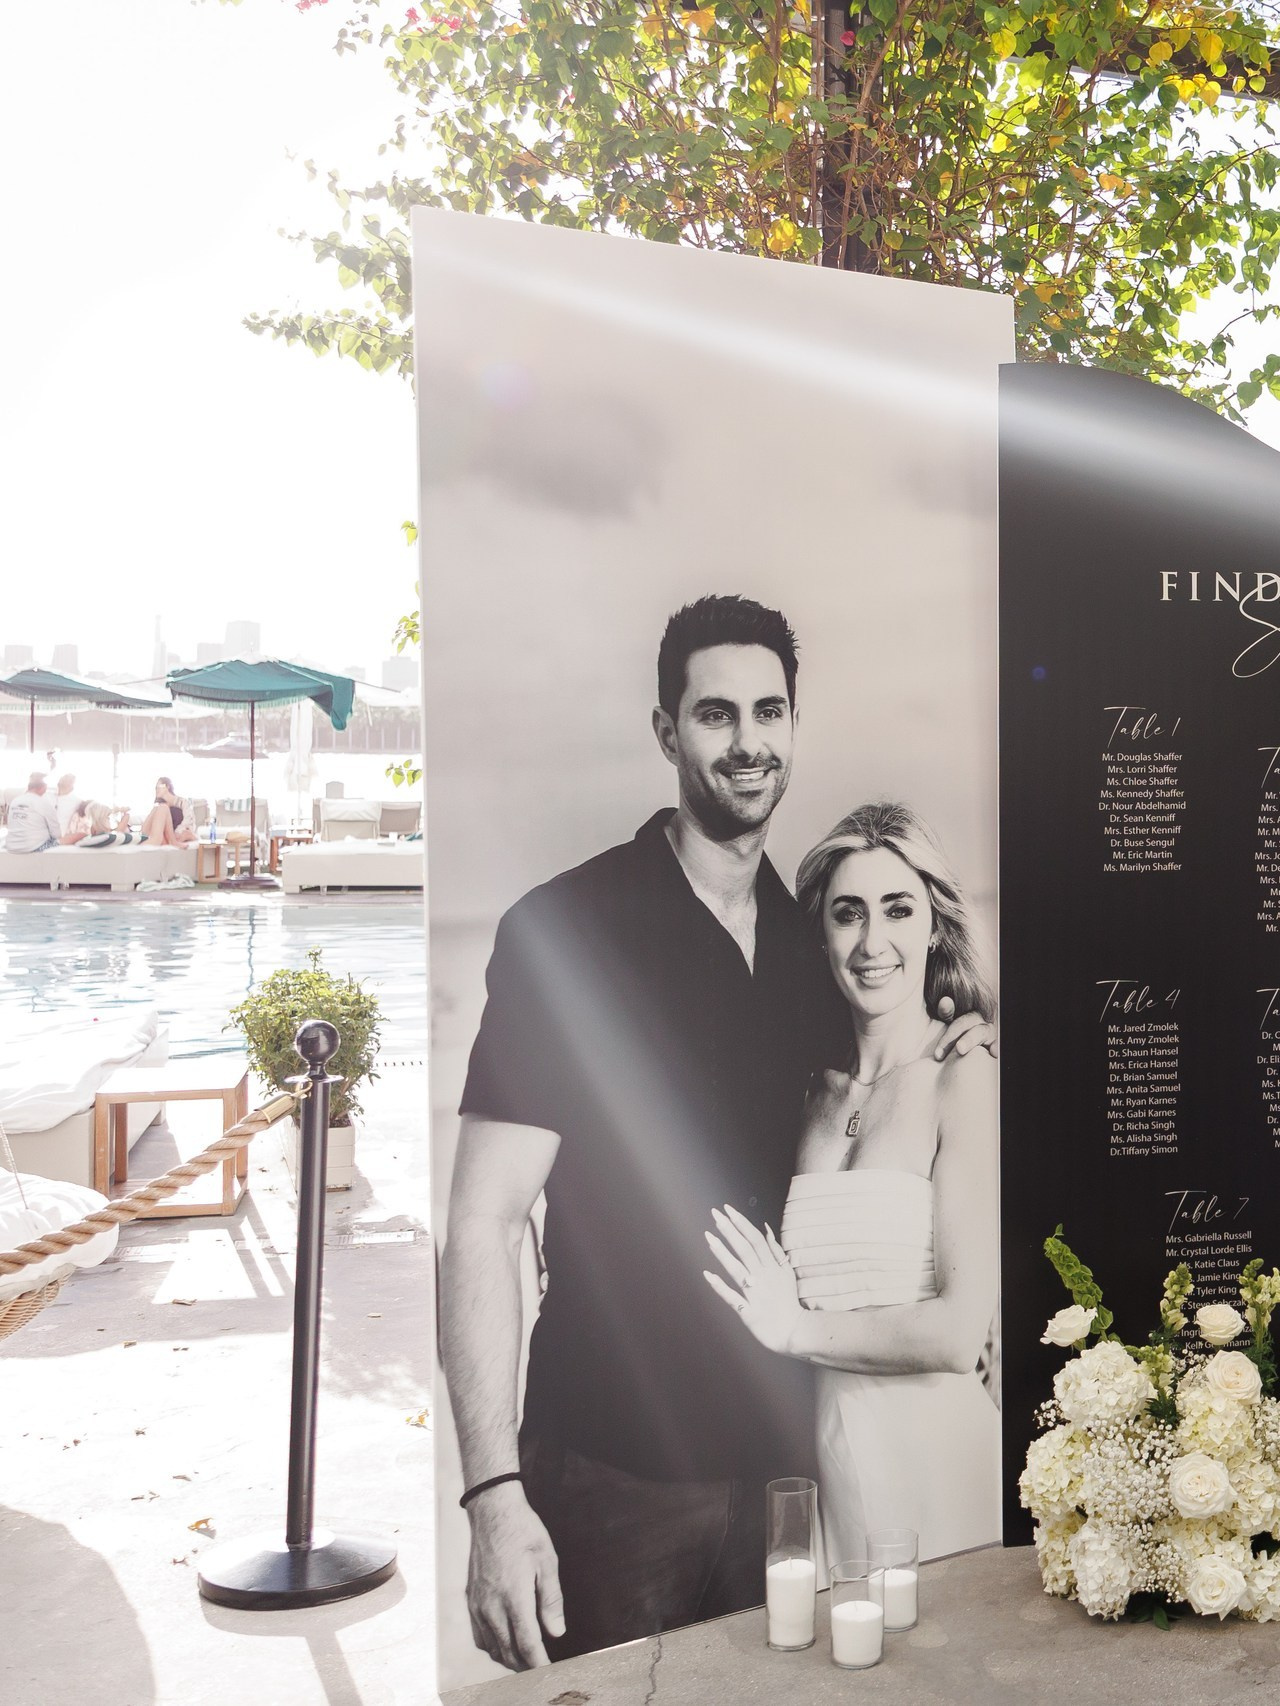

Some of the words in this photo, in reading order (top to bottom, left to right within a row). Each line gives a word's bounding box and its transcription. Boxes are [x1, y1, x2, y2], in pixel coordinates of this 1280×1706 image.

[1104, 706, 1165, 749] Table
[1171, 717, 1181, 737] 1
[1102, 753, 1115, 761] Mr.
[1117, 752, 1152, 763] Douglas
[1153, 752, 1183, 761] Shaffer
[1107, 777, 1121, 786] Ms.
[1122, 777, 1147, 786] Chloe
[1149, 776, 1178, 786] Shaffer
[1100, 790, 1115, 798] Ms.
[1116, 789, 1154, 800] Kennedy
[1155, 789, 1184, 798] Shaffer
[1265, 791, 1278, 799] Mr.
[1098, 802, 1111, 810] Dr.
[1112, 802, 1133, 810] Nour
[1261, 803, 1278, 812] Mrs.
[1104, 826, 1122, 835] Mrs.
[1123, 826, 1150, 835] Esther
[1151, 825, 1181, 834] Kenniff
[1257, 828, 1271, 836] Mr.
[1254, 852, 1272, 860] Mrs.
[1103, 863, 1118, 872] Ms.
[1119, 863, 1151, 873] Marilyn
[1152, 862, 1182, 871] Shaffer
[1256, 864, 1269, 872] Mr.
[1257, 912, 1274, 920] Mrs.
[1096, 980, 1158, 1023] Table
[1165, 989, 1181, 1010] 4
[1108, 1024, 1121, 1033] Mr.
[1123, 1023, 1146, 1033] Jared
[1147, 1022, 1179, 1032] Zmolek
[1262, 1031, 1273, 1040] Dr.
[1108, 1049, 1120, 1058] Dr.
[1122, 1048, 1149, 1057] Shaun
[1150, 1047, 1178, 1056] Hansel
[1257, 1056, 1268, 1064] Dr.
[1267, 1067, 1278, 1076] Dr.
[1106, 1086, 1124, 1094] Mrs.
[1126, 1085, 1148, 1094] Anita
[1150, 1083, 1181, 1093] Samuel
[1111, 1098, 1124, 1106] Mr.
[1126, 1098, 1147, 1108] Ryan
[1148, 1097, 1177, 1105] Karnes
[1267, 1116, 1279, 1124] Dr.
[1110, 1135, 1125, 1144] Ms.
[1126, 1134, 1152, 1143] Alisha
[1153, 1132, 1178, 1143] Singh
[1151, 1145, 1178, 1154] Simon
[1165, 1190, 1226, 1233] Table
[1233, 1197, 1250, 1220] 7
[1166, 1235, 1183, 1243] Mrs.
[1185, 1232, 1222, 1242] Gabriella
[1223, 1230, 1252, 1240] Russell
[1166, 1248, 1179, 1257] Mr.
[1180, 1246, 1209, 1258] Crystal
[1211, 1245, 1235, 1254] Lorde
[1236, 1244, 1252, 1253] Ellis
[1194, 1260, 1216, 1269] Katie
[1217, 1258, 1240, 1267] Claus
[1196, 1273, 1221, 1282] Jamie
[1196, 1286, 1216, 1298] Tyler
[1218, 1286, 1237, 1295] King
